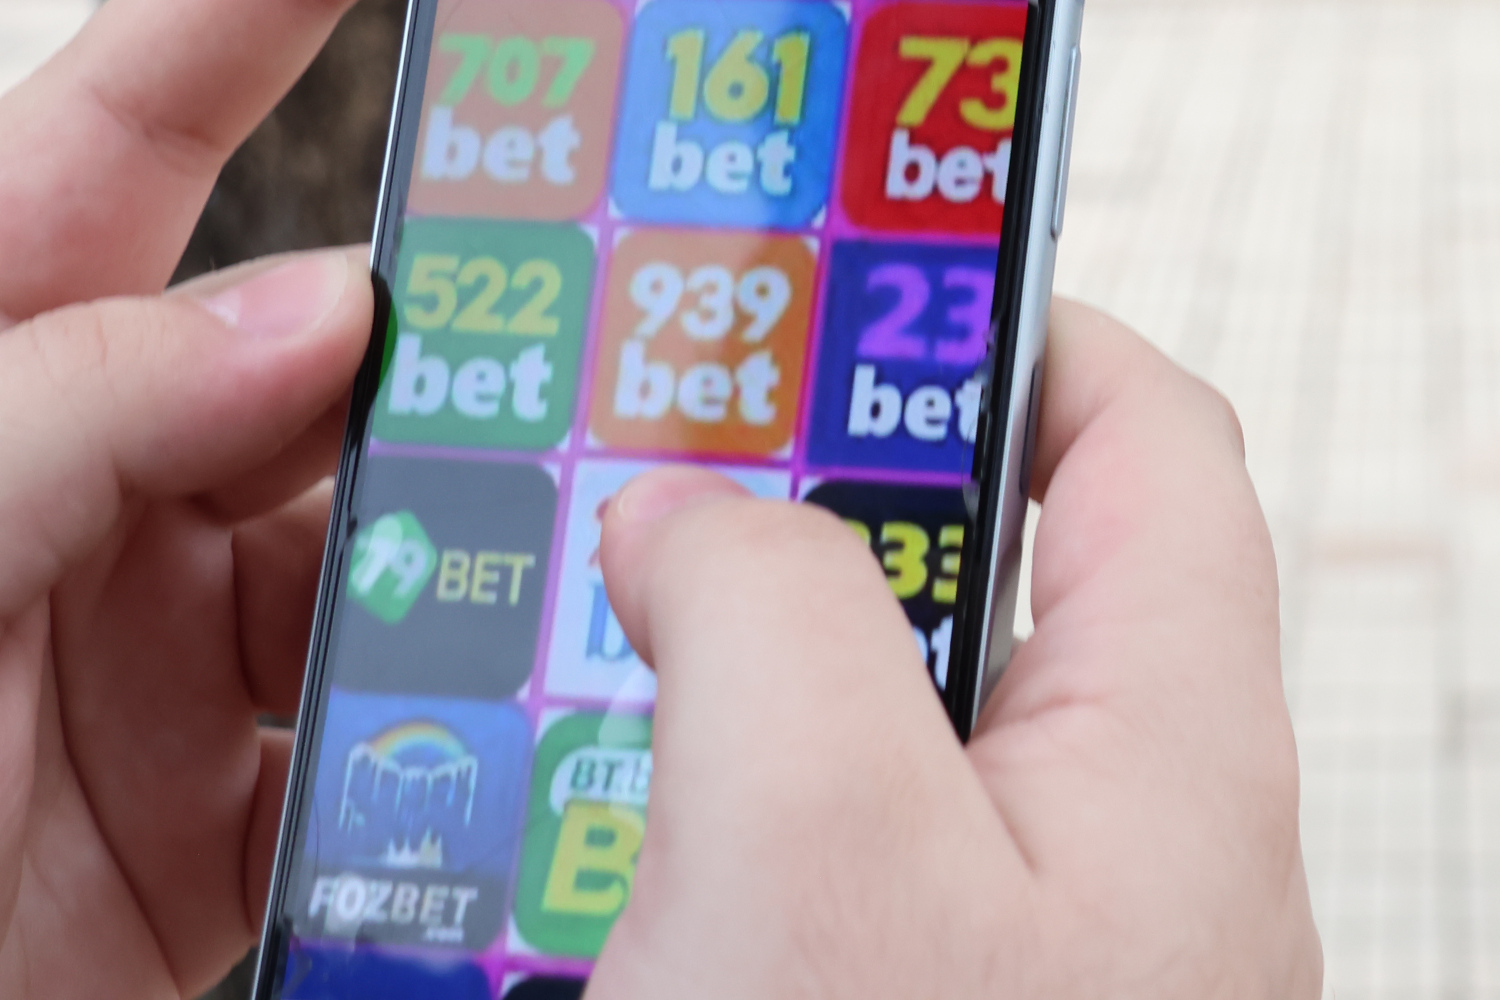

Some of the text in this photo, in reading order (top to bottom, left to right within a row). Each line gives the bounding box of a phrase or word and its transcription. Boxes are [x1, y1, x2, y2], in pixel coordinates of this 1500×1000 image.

[438, 32, 596, 109] 707
[664, 28, 811, 127] 161
[896, 34, 1023, 132] 73
[420, 104, 582, 187] bet
[648, 120, 796, 197] bet
[884, 126, 1012, 206] bet
[403, 253, 563, 336] 522
[628, 262, 792, 344] 939
[856, 261, 996, 366] 23
[387, 332, 554, 422] bet
[613, 338, 781, 427] bet
[847, 363, 982, 444] bet
[352, 533, 537, 607] 79 BET
[308, 872, 479, 928] FOZBET
